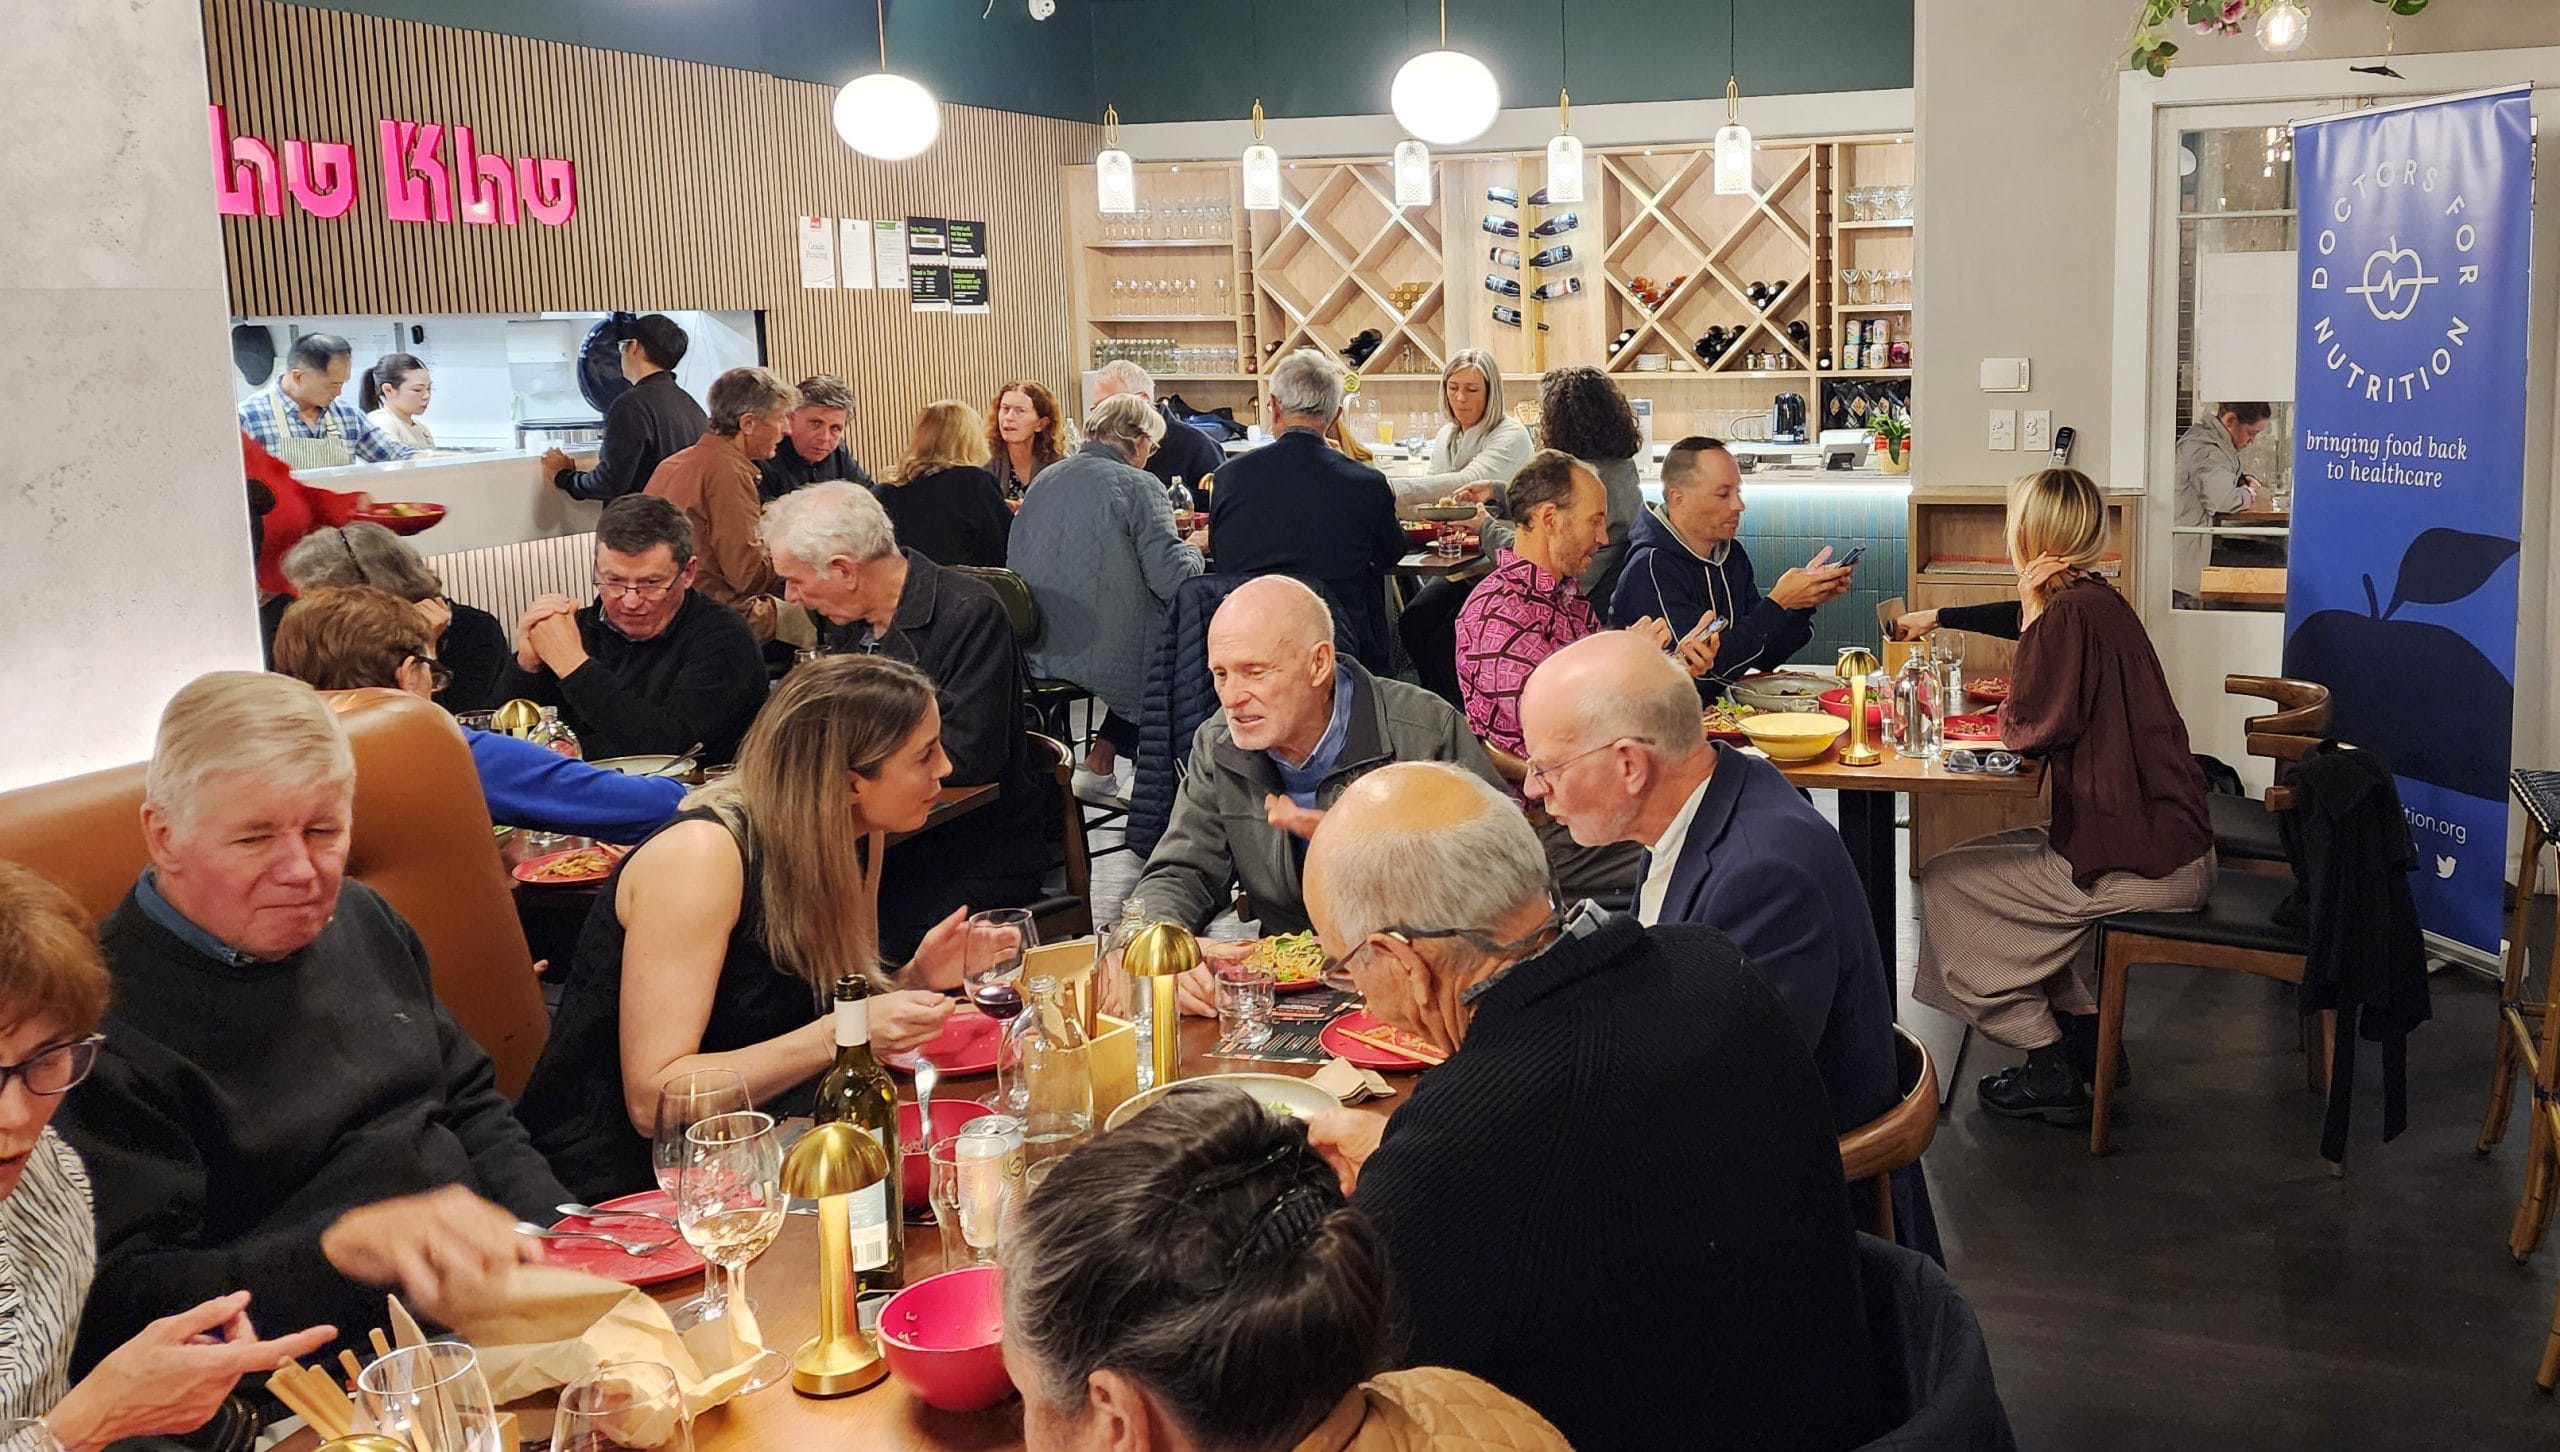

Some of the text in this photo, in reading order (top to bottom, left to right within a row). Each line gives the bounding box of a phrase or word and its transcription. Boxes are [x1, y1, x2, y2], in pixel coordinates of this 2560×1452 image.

[208, 104, 576, 226] hu Khu
[2311, 159, 2479, 289] DOCTORS FOR
[2314, 315, 2470, 402] NUTRITION
[2306, 430, 2467, 461] bringing food back
[2327, 460, 2443, 488] to healthcare
[2402, 804, 2466, 844] tion.org
